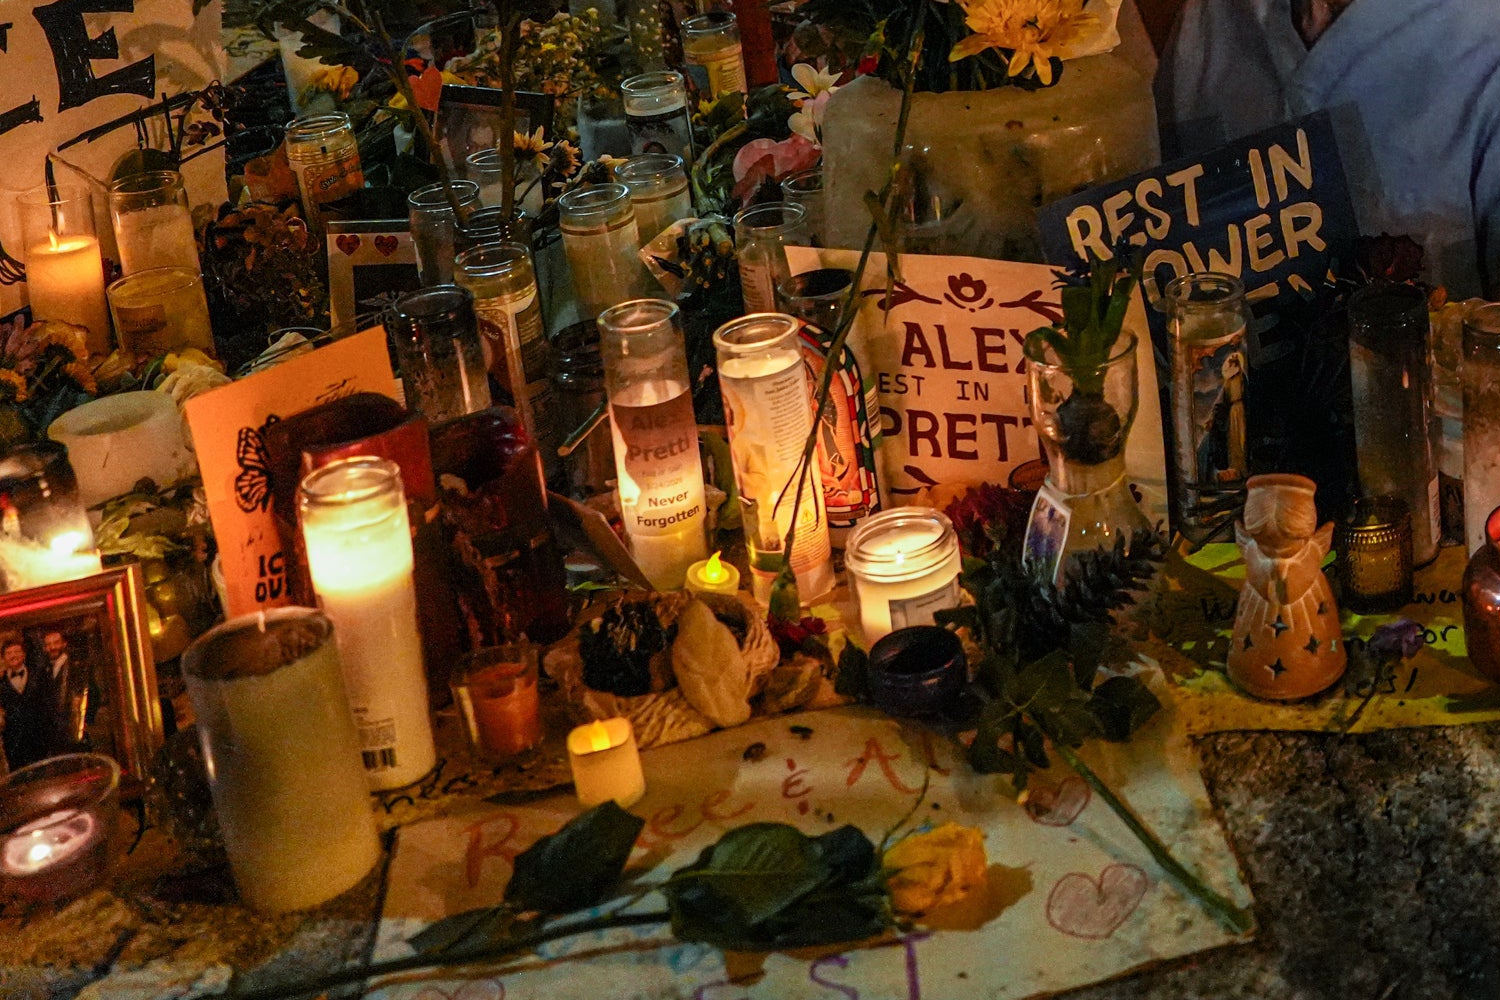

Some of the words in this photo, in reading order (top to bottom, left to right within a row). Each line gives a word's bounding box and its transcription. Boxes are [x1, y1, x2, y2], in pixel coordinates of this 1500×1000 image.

[1066, 163, 1204, 263] REST
[1248, 128, 1313, 209] IN
[1143, 201, 1327, 304] OWER
[878, 372, 925, 397] EST
[956, 380, 989, 402] IN
[880, 406, 1050, 465] PRETT
[648, 490, 688, 508] Never
[637, 504, 700, 529] Forgotten
[259, 551, 284, 578] IC
